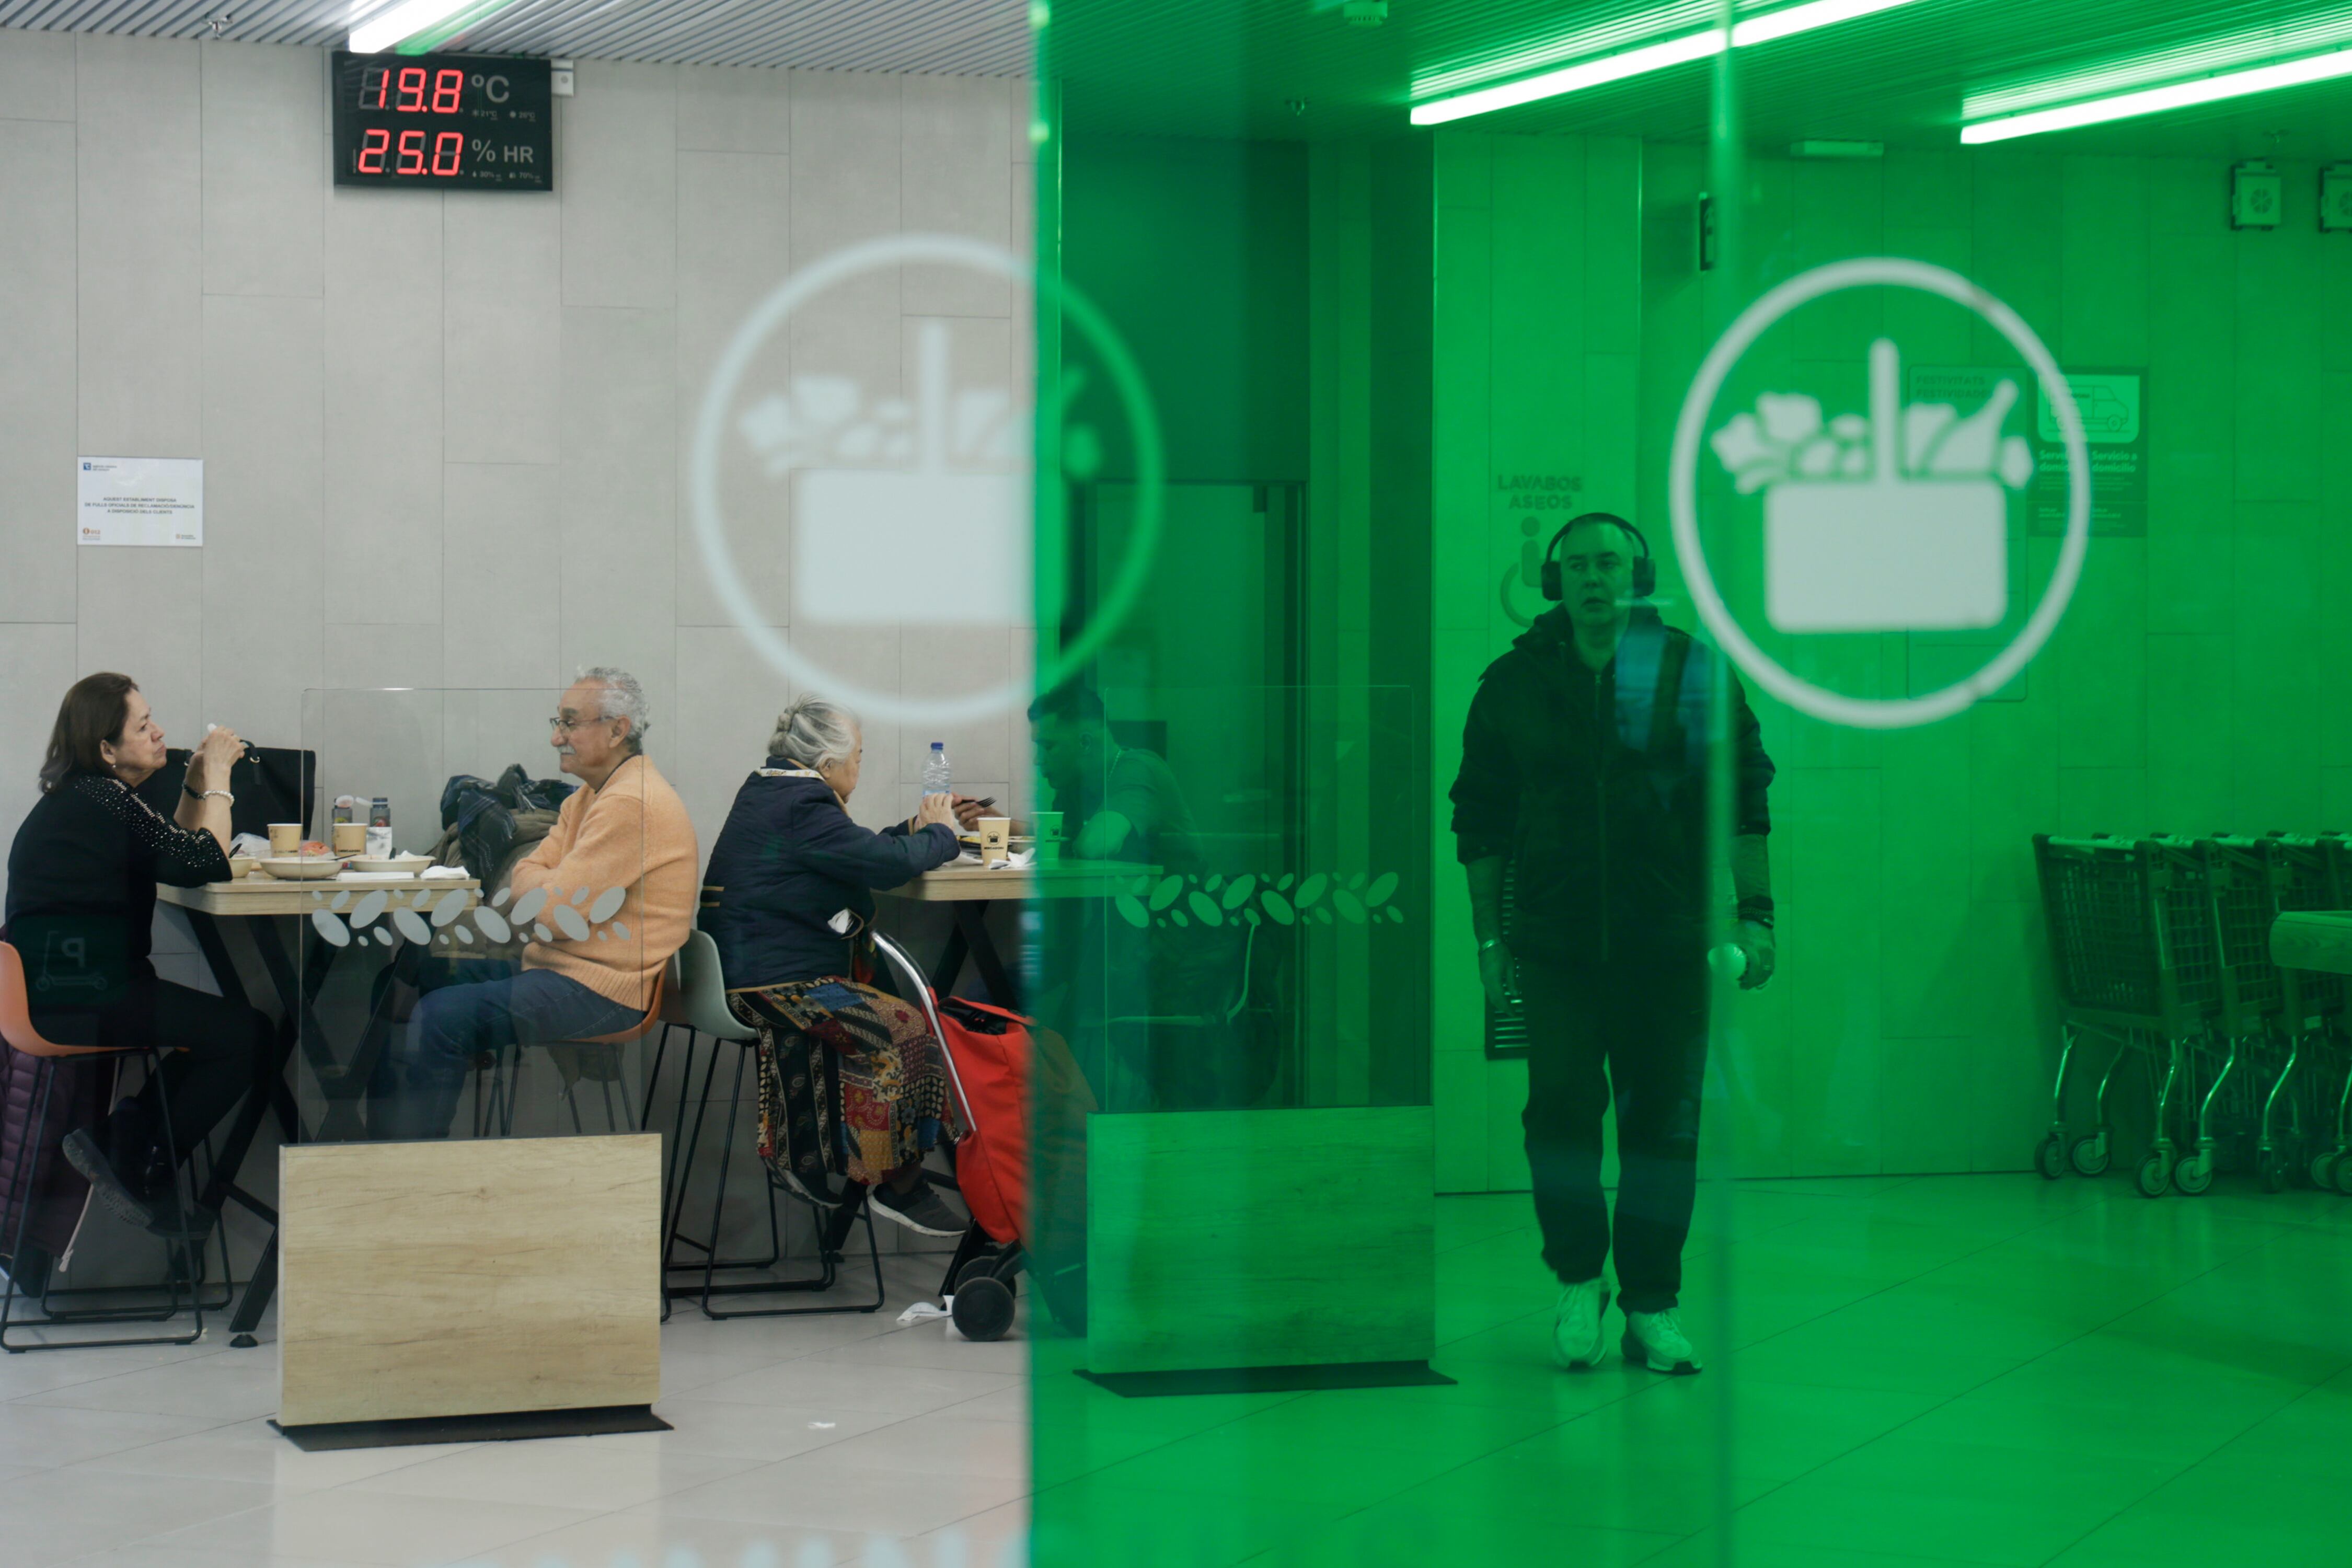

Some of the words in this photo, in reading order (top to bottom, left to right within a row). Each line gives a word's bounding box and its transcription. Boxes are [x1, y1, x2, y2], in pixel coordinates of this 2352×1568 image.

[378, 67, 463, 113] 19.8
[358, 129, 463, 176] 25.0
[472, 139, 496, 162] %
[504, 145, 533, 163] HR
[1916, 375, 1985, 385] FESTIVITATS
[2092, 450, 2130, 461] Servicio
[2092, 462, 2136, 472] domicilio
[1497, 475, 1584, 491] LAVABOS
[1508, 493, 1572, 510] ASEOS
